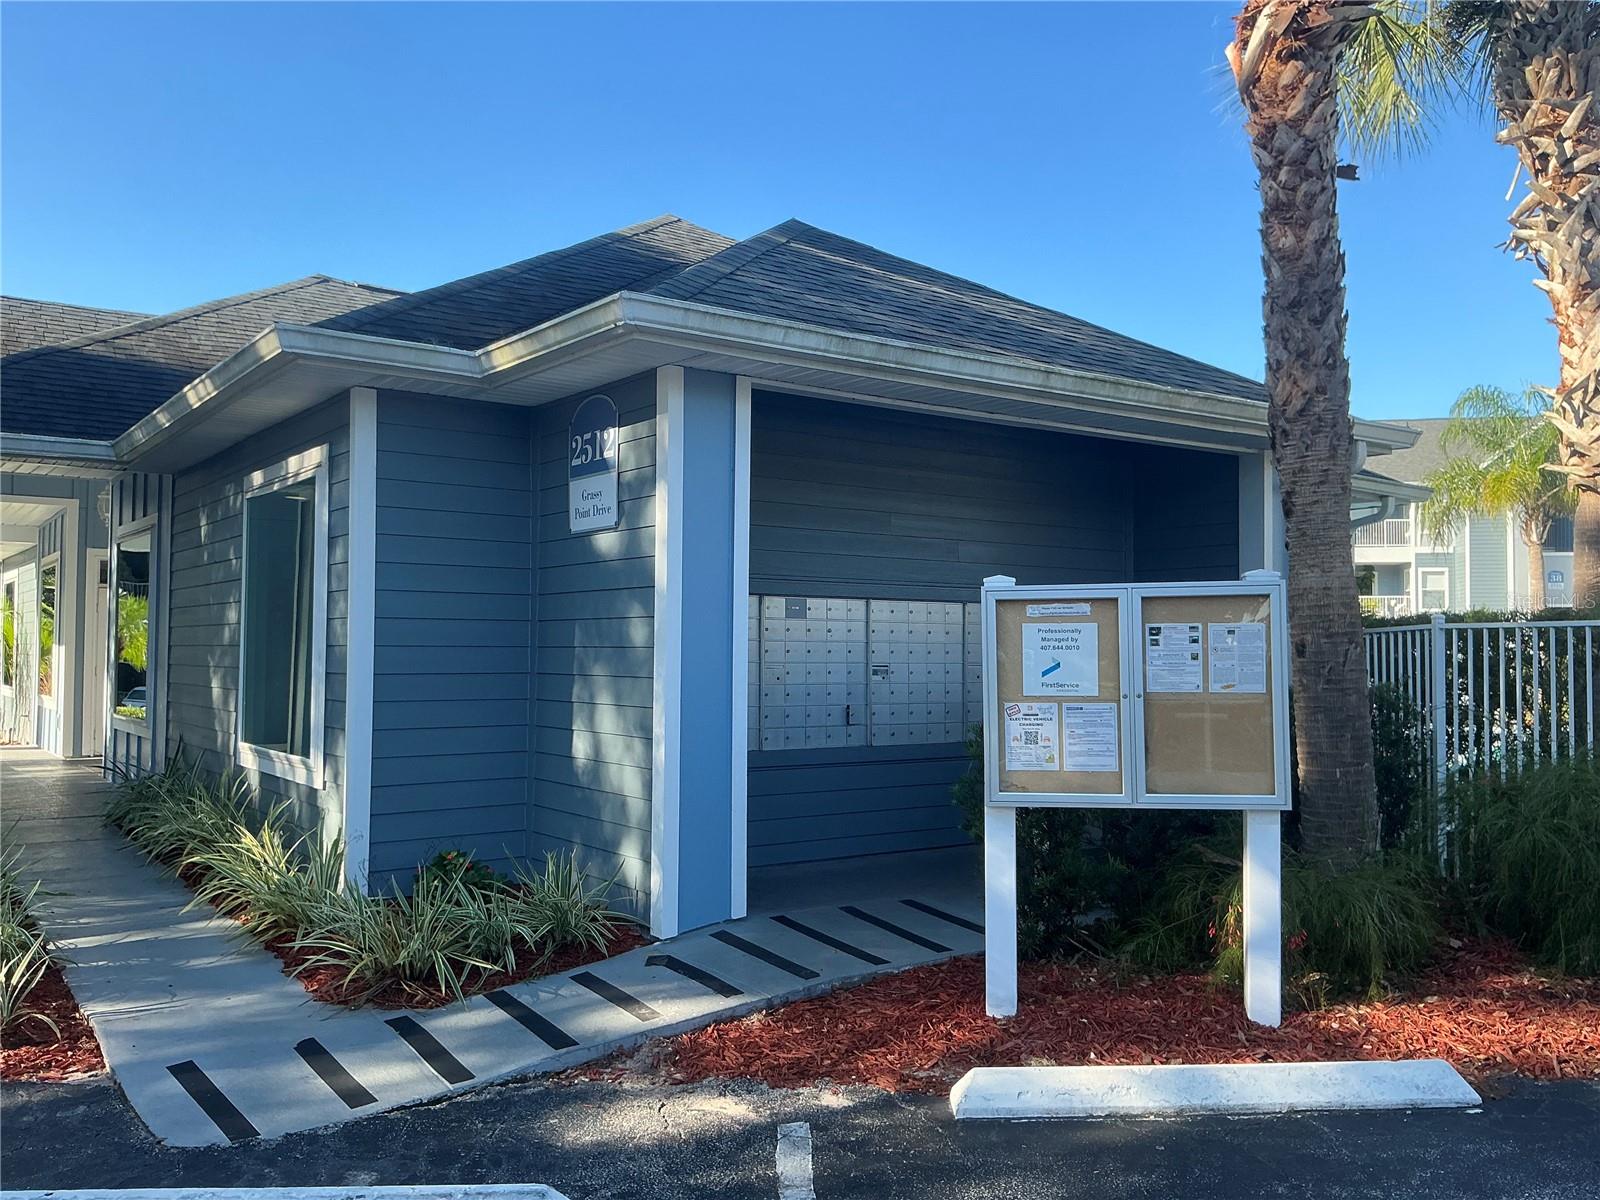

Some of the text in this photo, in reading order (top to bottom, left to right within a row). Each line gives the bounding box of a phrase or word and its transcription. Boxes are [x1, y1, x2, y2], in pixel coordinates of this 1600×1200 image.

[571, 426, 615, 466] 2512
[581, 489, 603, 502] Grassy
[574, 503, 612, 520] Point Drive
[1037, 627, 1082, 635] Professionally
[1041, 636, 1079, 644] Managed by
[1041, 681, 1080, 689] FirstService
